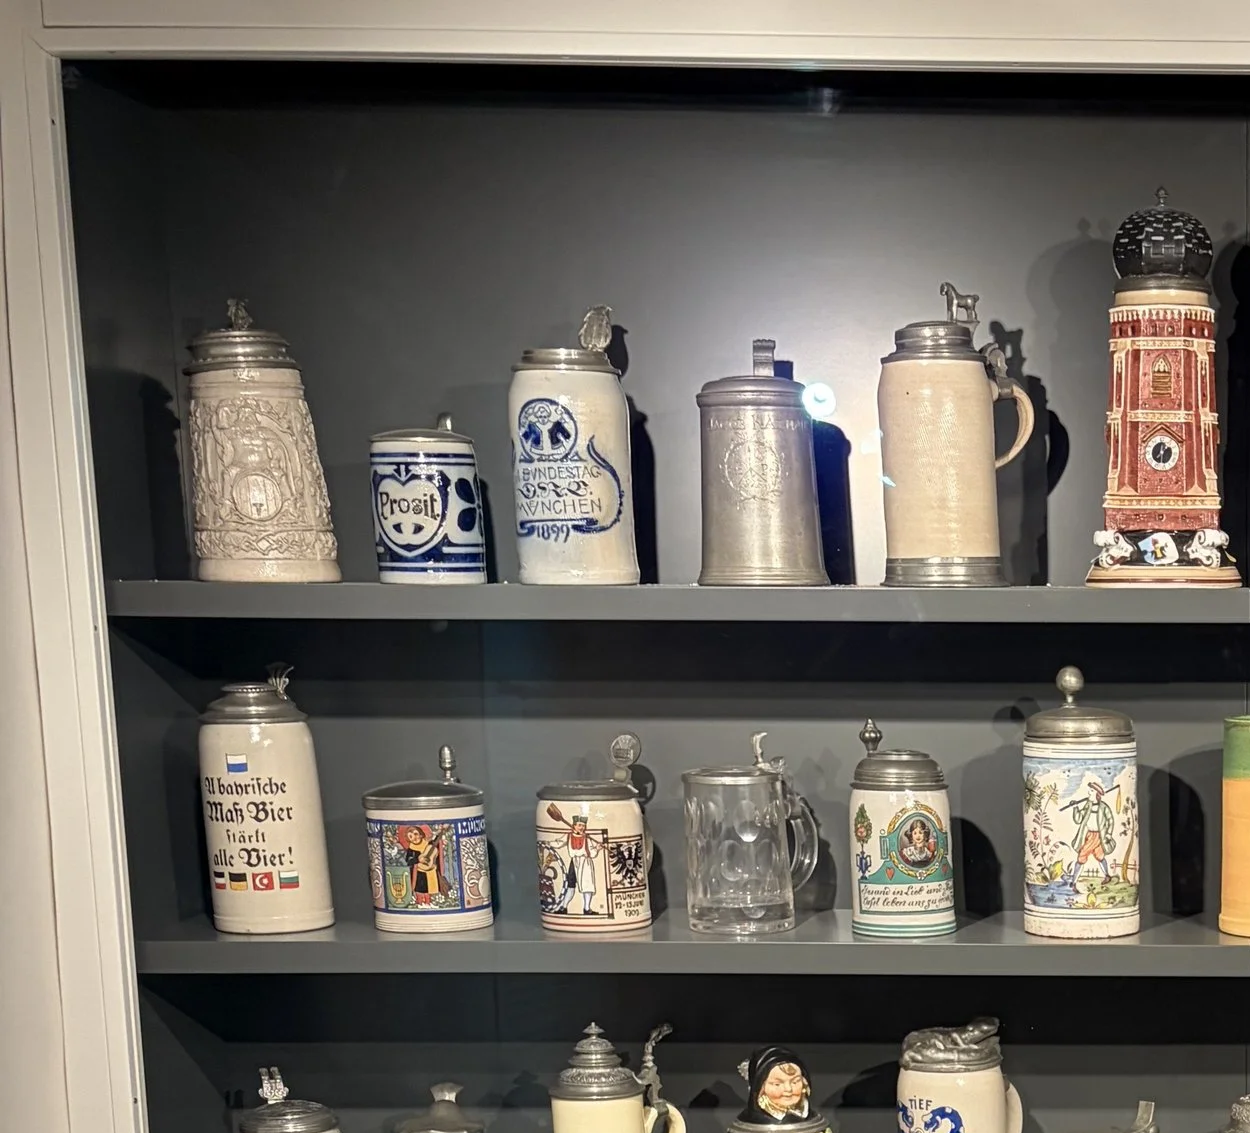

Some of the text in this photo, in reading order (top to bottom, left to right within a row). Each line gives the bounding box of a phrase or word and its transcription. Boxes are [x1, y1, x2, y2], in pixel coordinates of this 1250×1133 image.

[379, 491, 440, 520] Prosit.
[246, 800, 293, 823] Bier
[214, 848, 234, 867] alle
